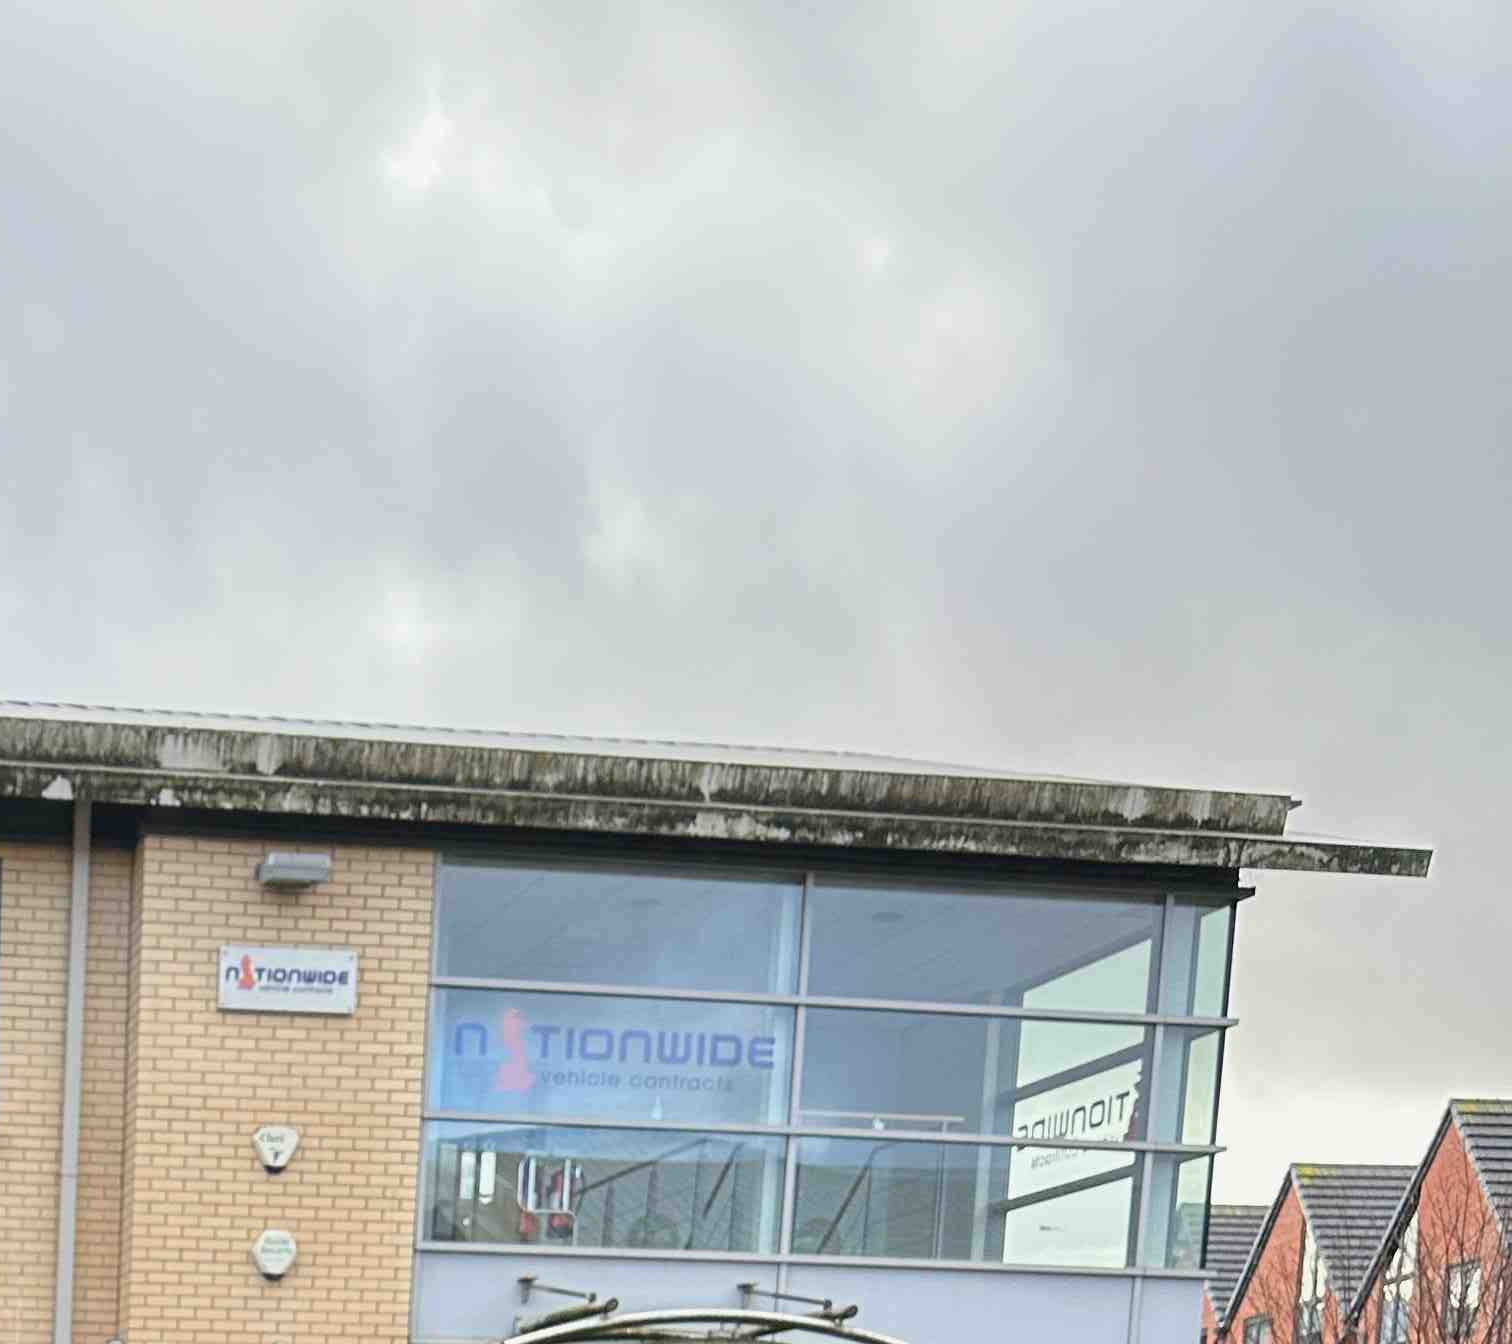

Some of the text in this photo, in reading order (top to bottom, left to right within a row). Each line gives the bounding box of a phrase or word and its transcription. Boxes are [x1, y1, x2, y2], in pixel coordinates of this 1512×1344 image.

[454, 1022, 776, 1069] NTIONWIDE
[540, 1069, 734, 1093] vehicle contracts
